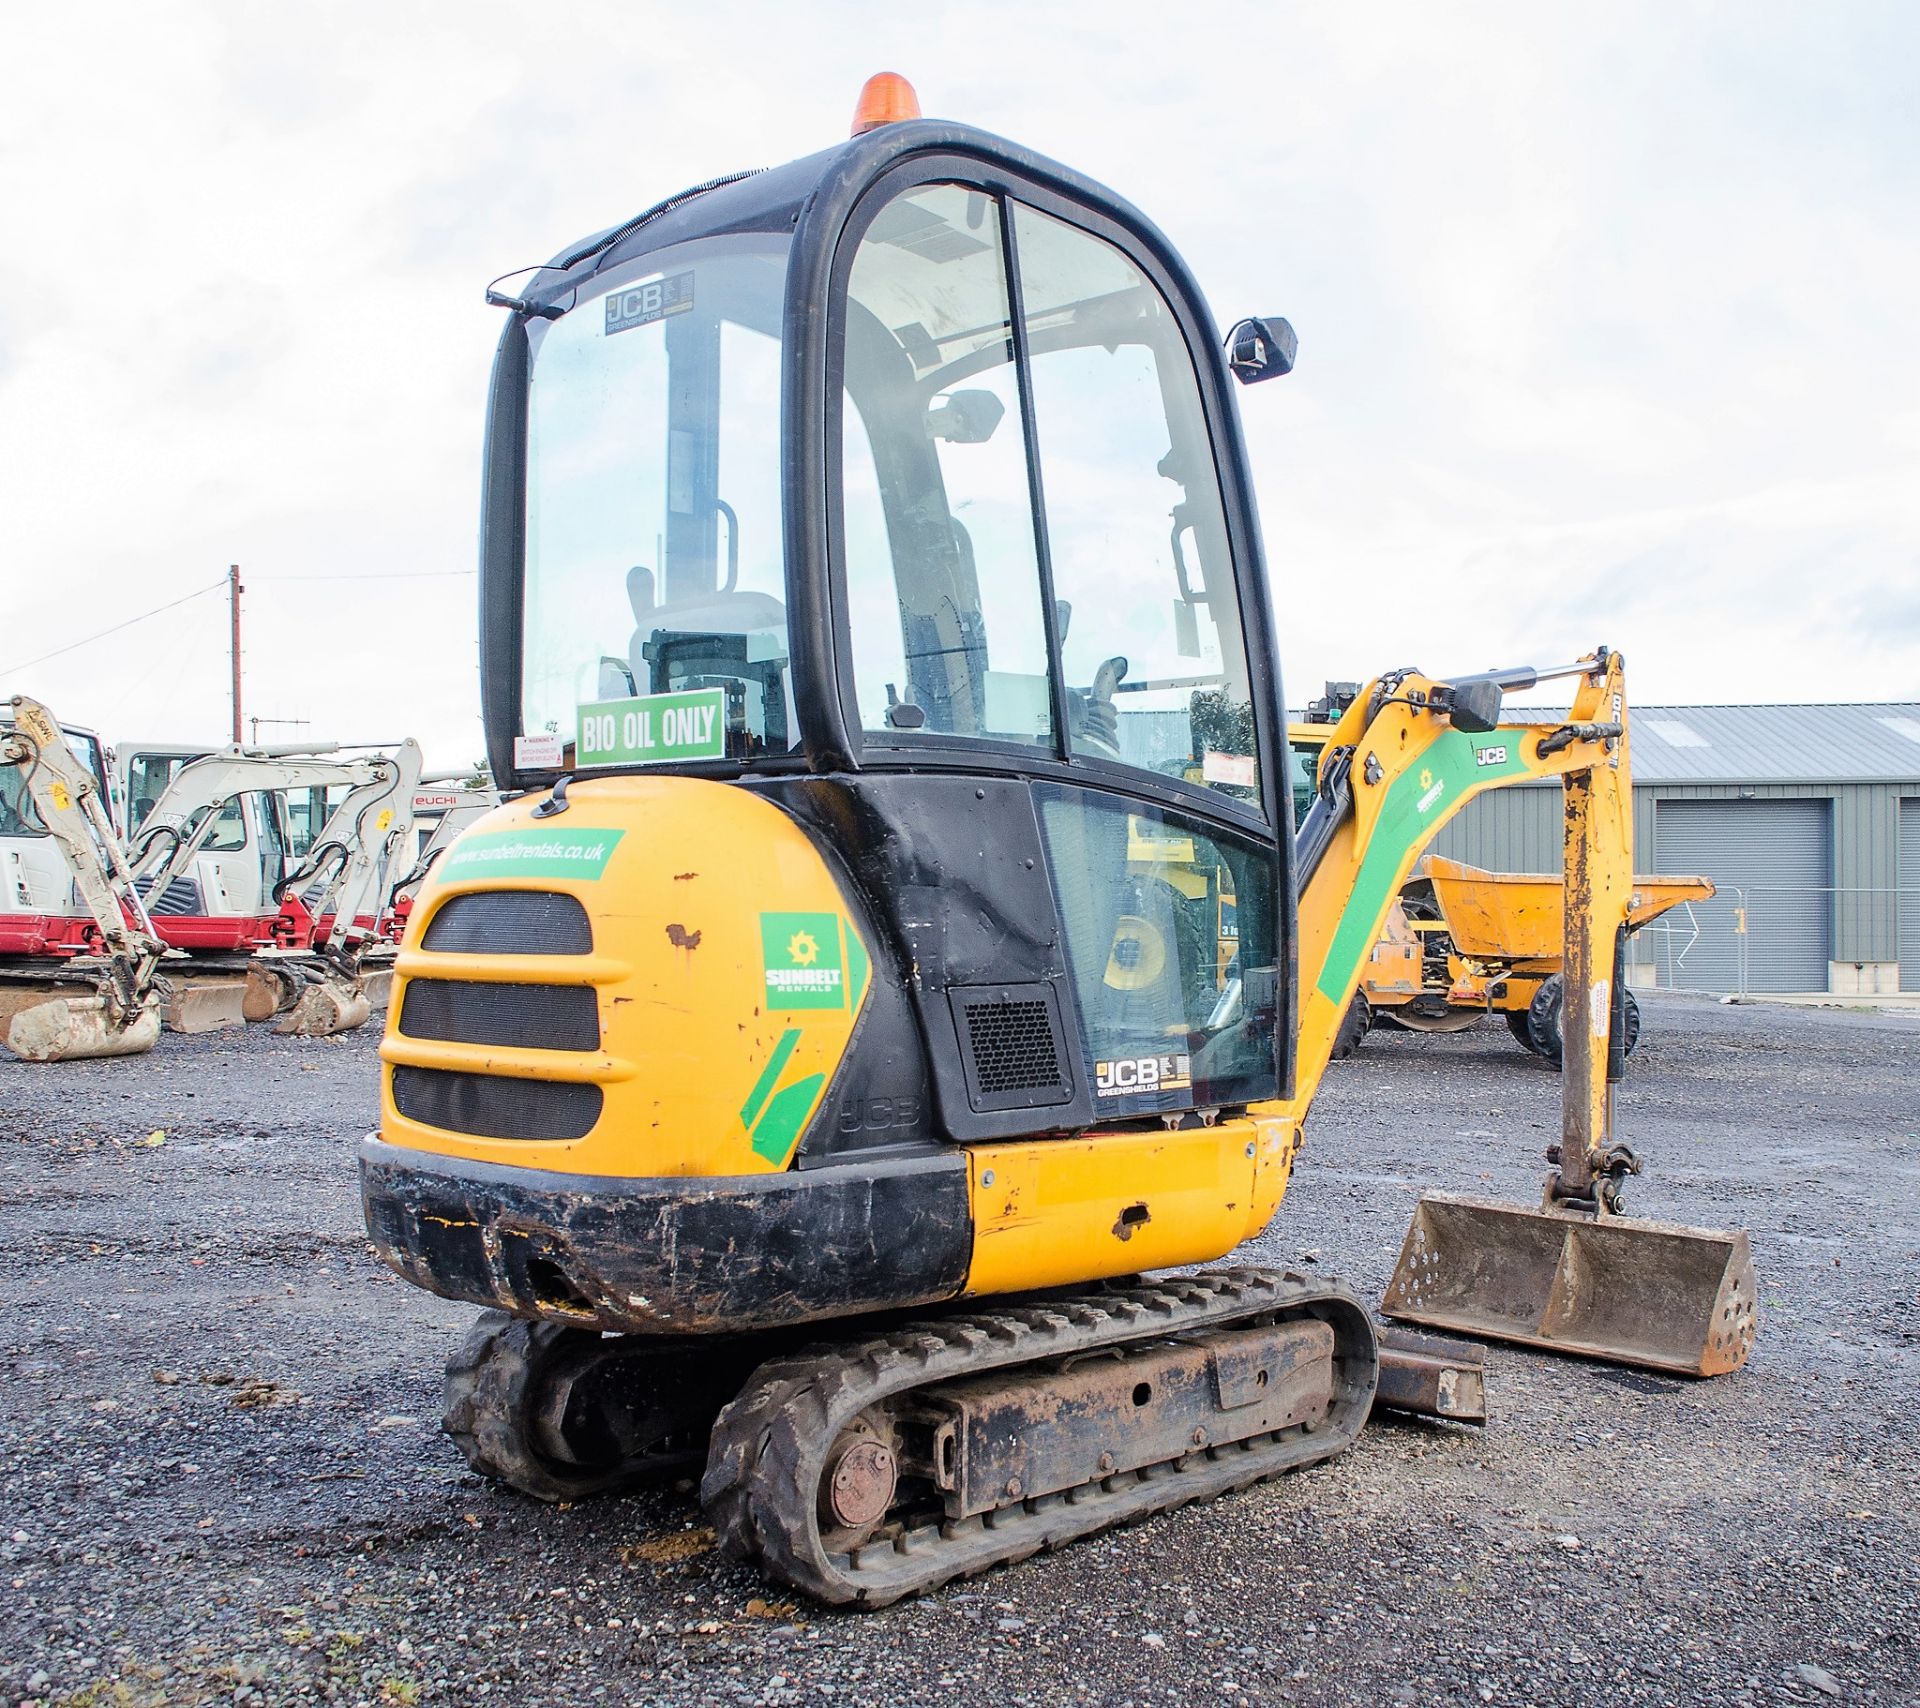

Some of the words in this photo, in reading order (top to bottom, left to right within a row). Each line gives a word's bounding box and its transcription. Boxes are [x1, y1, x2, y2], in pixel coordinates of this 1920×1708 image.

[608, 285, 662, 323] JCB
[607, 311, 662, 332] GREENSHIELDS
[583, 715, 616, 752] BIO
[623, 712, 656, 749] OIL
[662, 705, 716, 747] ONLY
[1477, 747, 1506, 766] JCB
[766, 969, 840, 986] SUNBELT
[1096, 1058, 1160, 1088] JCB
[1097, 1083, 1159, 1097] GREENSHIELDS
[841, 1097, 920, 1132] JCB
